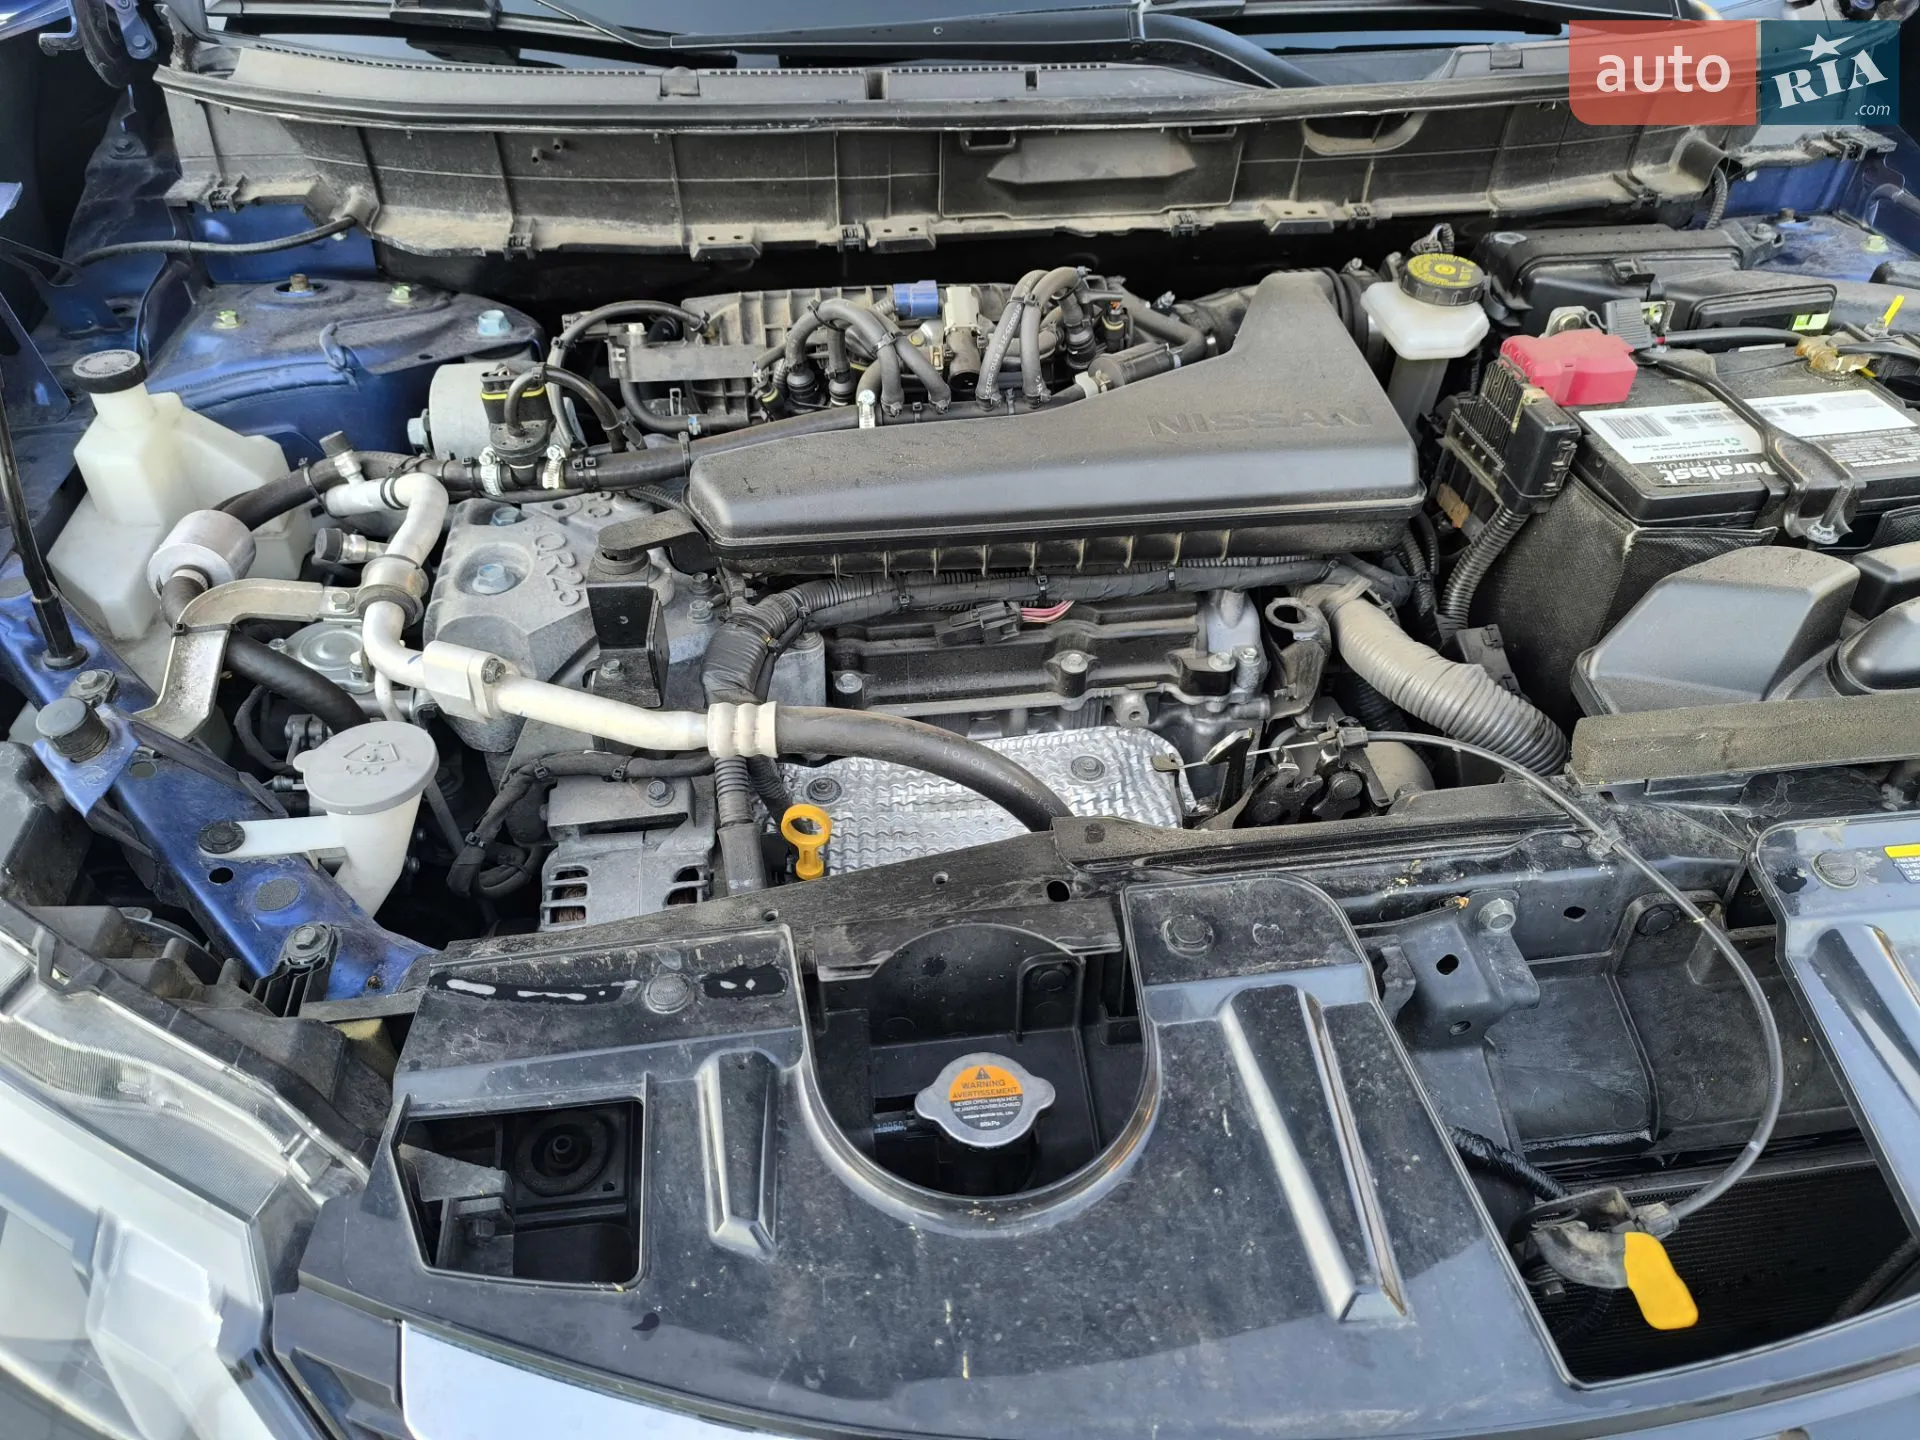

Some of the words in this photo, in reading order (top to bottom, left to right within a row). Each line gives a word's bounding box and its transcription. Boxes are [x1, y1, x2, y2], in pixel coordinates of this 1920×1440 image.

[1147, 406, 1373, 437] NISSAN
[961, 1079, 1006, 1089] WARNING
[952, 1087, 1017, 1098] AVERTISSEMENT
